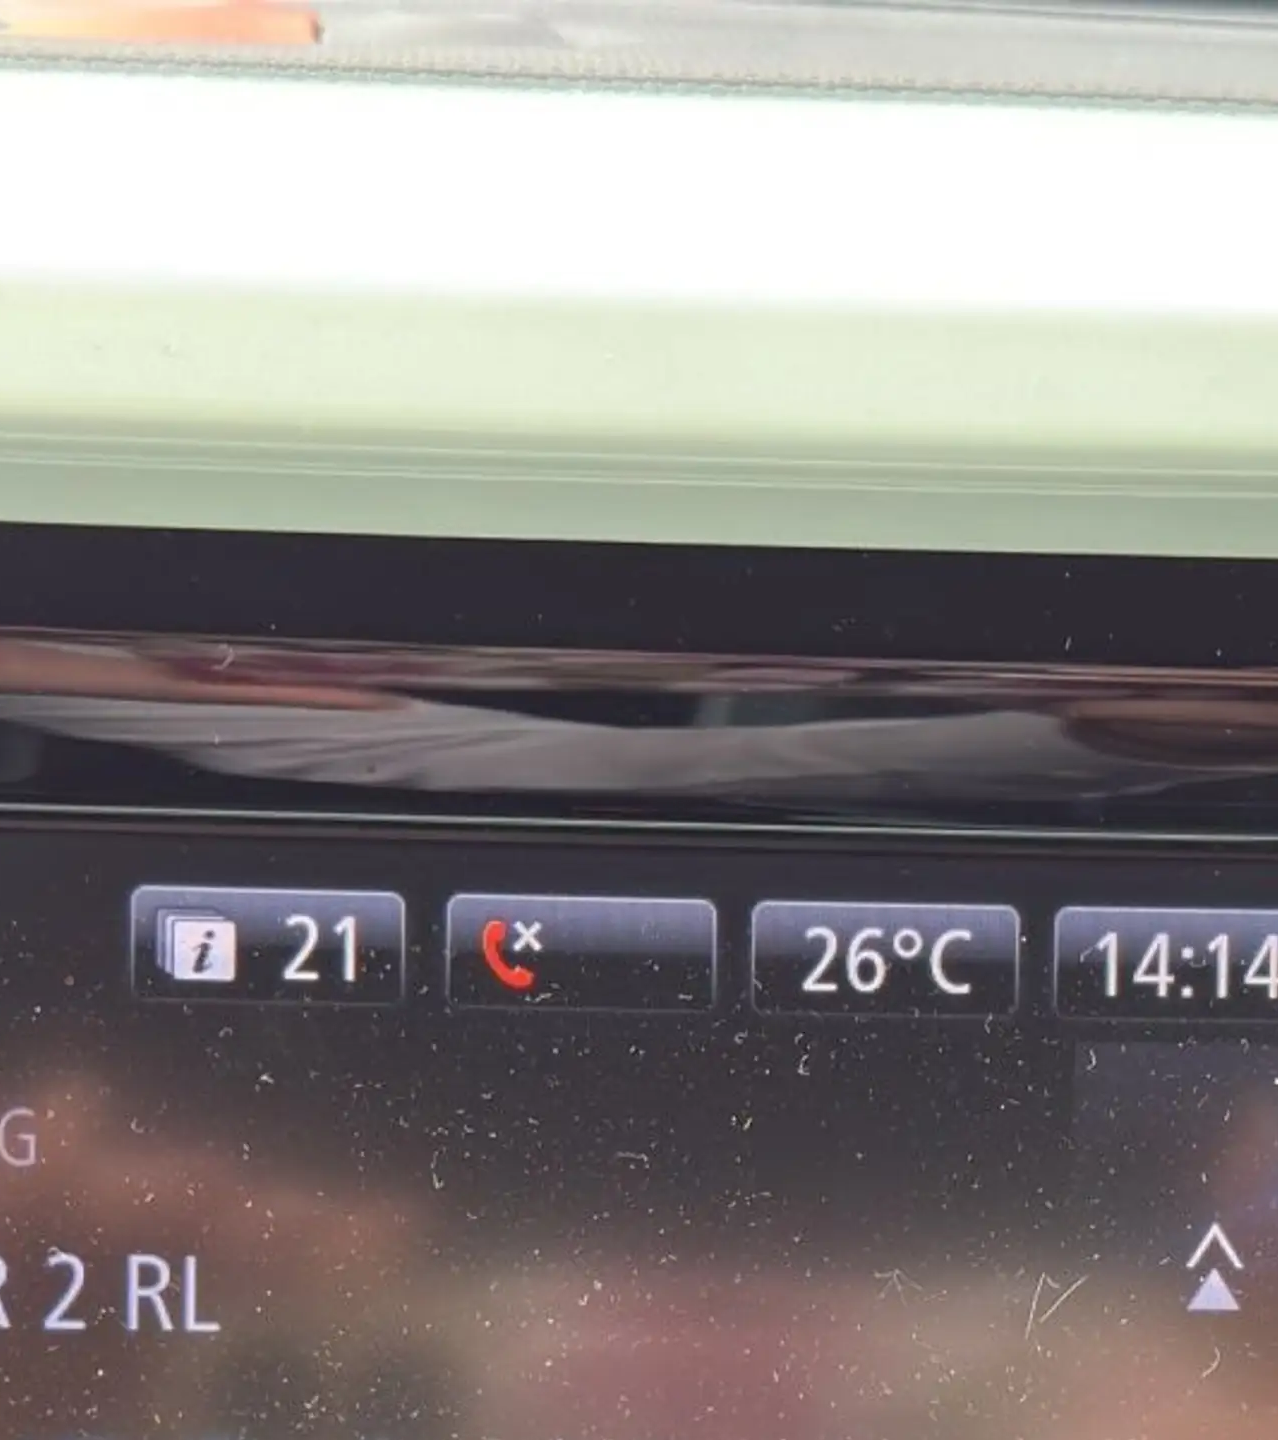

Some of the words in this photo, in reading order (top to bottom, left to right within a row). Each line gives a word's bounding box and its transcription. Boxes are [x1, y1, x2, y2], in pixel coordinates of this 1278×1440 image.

[283, 915, 359, 980] 21
[803, 926, 972, 993] 26°C
[46, 1250, 85, 1330] 2
[126, 1253, 219, 1332] RL
